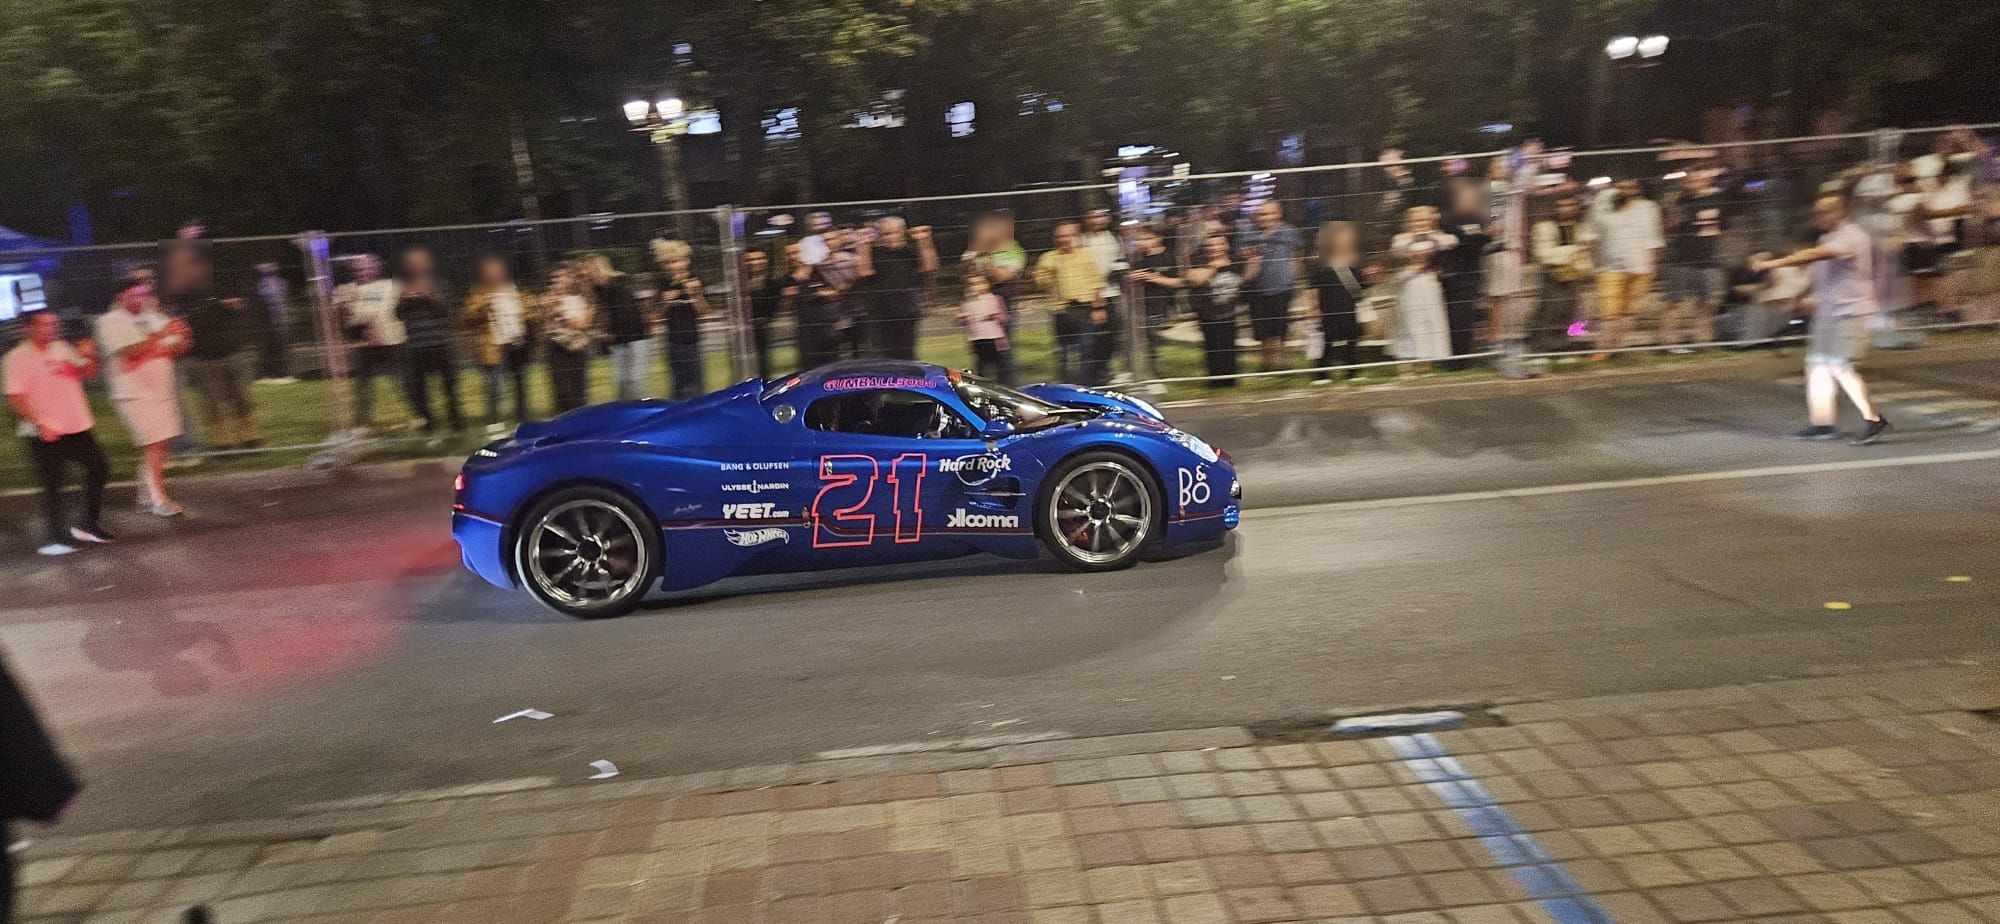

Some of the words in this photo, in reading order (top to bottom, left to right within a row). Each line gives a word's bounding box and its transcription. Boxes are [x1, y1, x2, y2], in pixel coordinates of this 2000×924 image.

[939, 458, 976, 472] Hard
[977, 454, 1011, 473] Rock
[811, 453, 926, 548] 21
